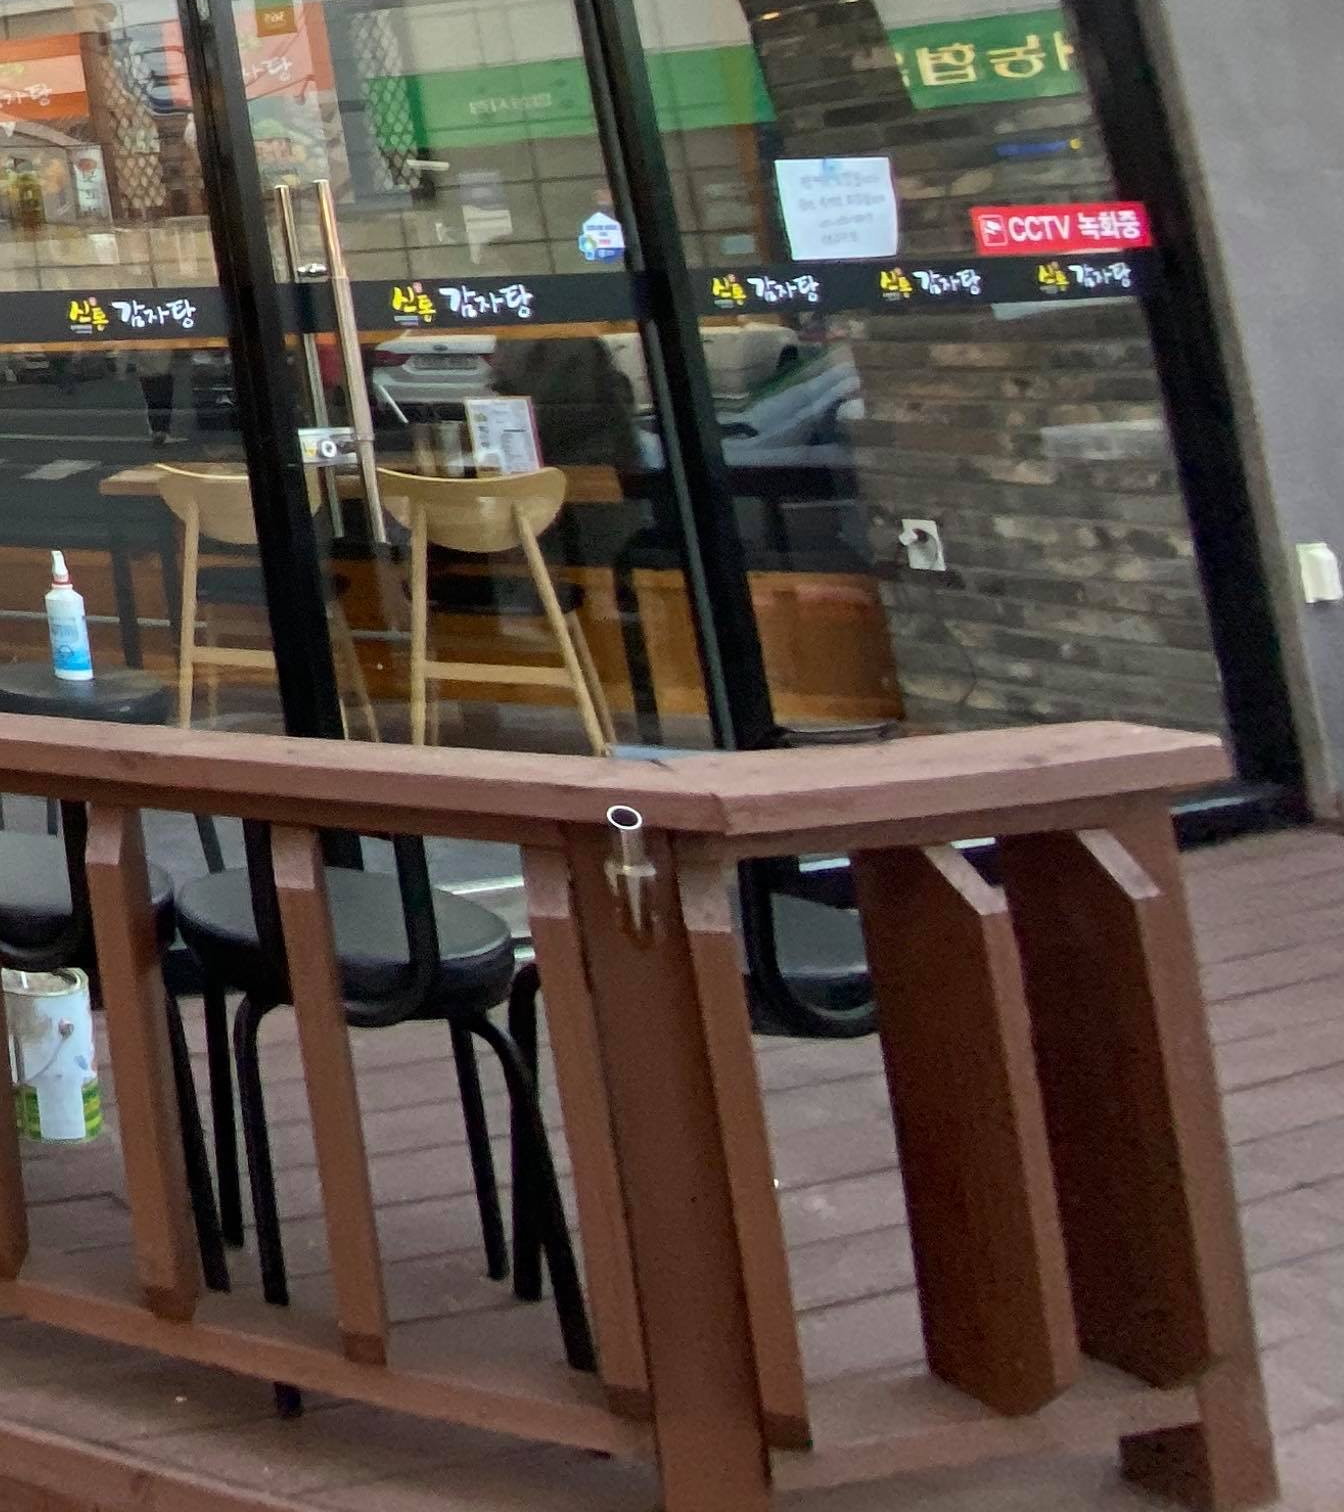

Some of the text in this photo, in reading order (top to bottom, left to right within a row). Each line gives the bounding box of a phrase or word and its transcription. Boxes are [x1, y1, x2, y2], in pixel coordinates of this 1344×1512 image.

[1008, 209, 1141, 243] CCTV 녹화중
[111, 298, 197, 330] 감자탕
[438, 283, 534, 319] 감자탕
